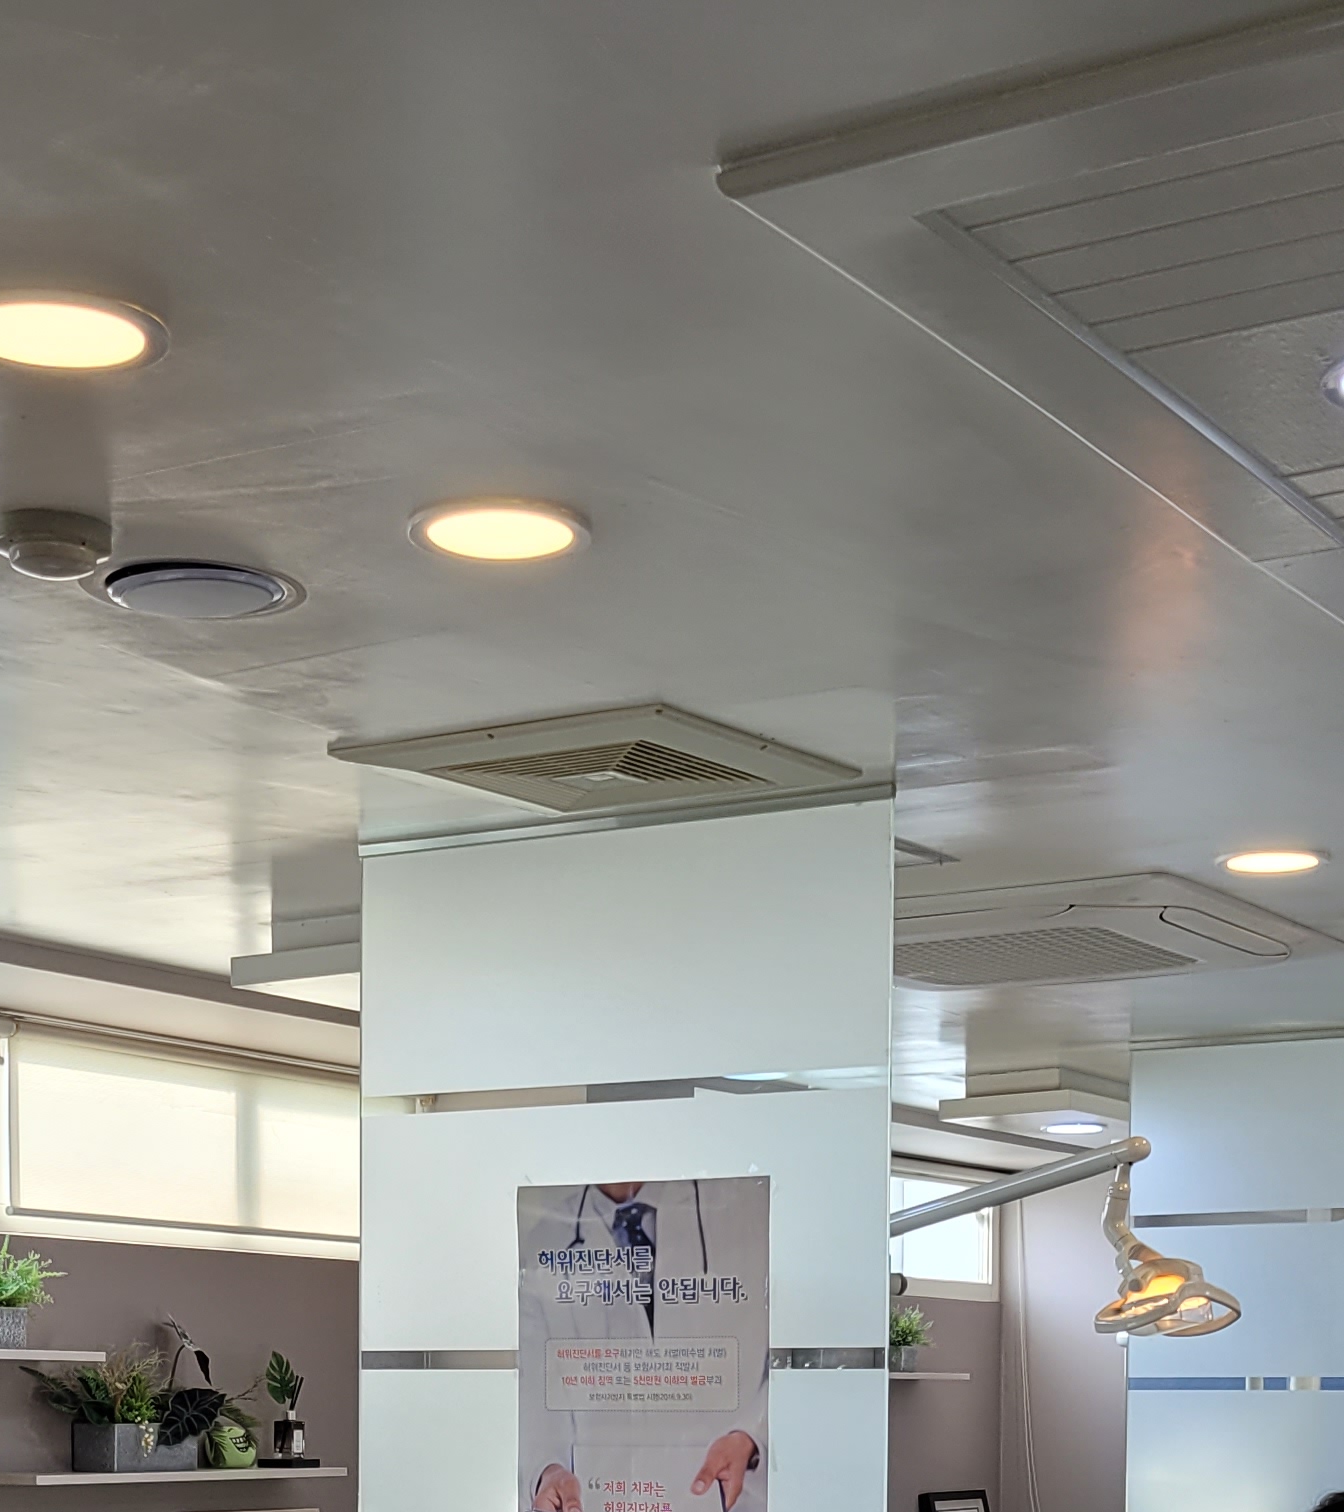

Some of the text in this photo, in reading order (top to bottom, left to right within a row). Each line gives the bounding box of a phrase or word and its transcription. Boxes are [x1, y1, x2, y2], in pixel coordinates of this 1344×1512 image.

[537, 1246, 652, 1273] 허위진단서를
[555, 1276, 745, 1303] 요구해서는 안됩니다.
[603, 1481, 666, 1498] 저희 치과는
